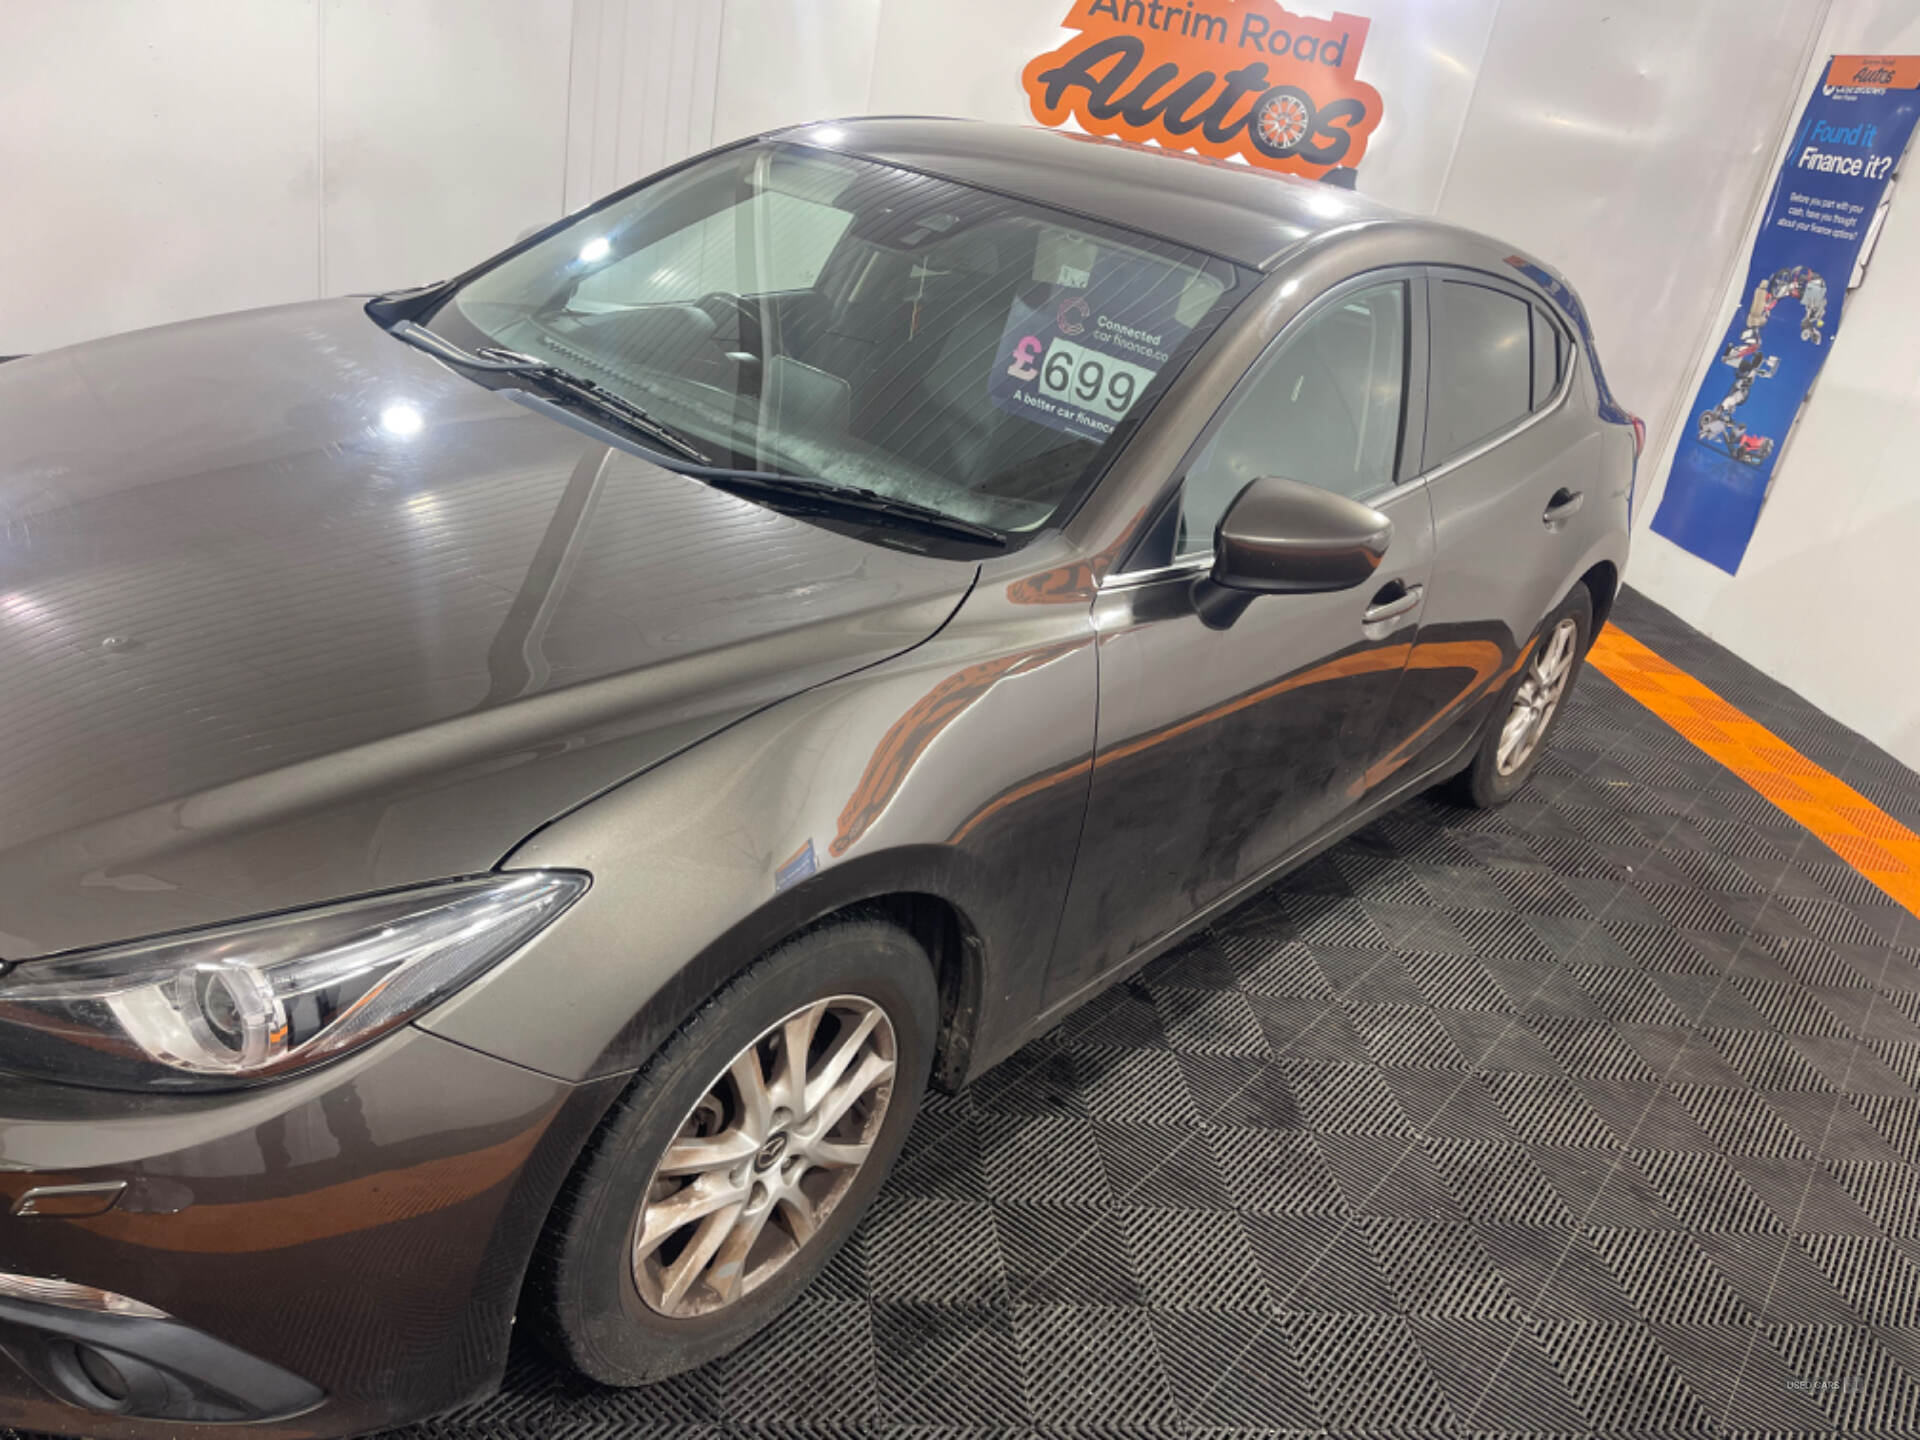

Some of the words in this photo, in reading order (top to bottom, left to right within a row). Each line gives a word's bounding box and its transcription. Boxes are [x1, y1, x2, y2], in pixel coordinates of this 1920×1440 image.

[1087, 0, 1227, 43] Antrim
[1239, 13, 1349, 68] Road
[1037, 35, 1367, 165] Autos
[1810, 119, 1863, 146] Found
[1862, 122, 1877, 148] it
[1798, 146, 1863, 176] Finance
[1864, 154, 1893, 180] it?
[1093, 329, 1112, 342] car
[1097, 315, 1163, 346] Connected
[1013, 390, 1023, 401] A
[1024, 392, 1057, 413] better
[1057, 406, 1075, 419] car
